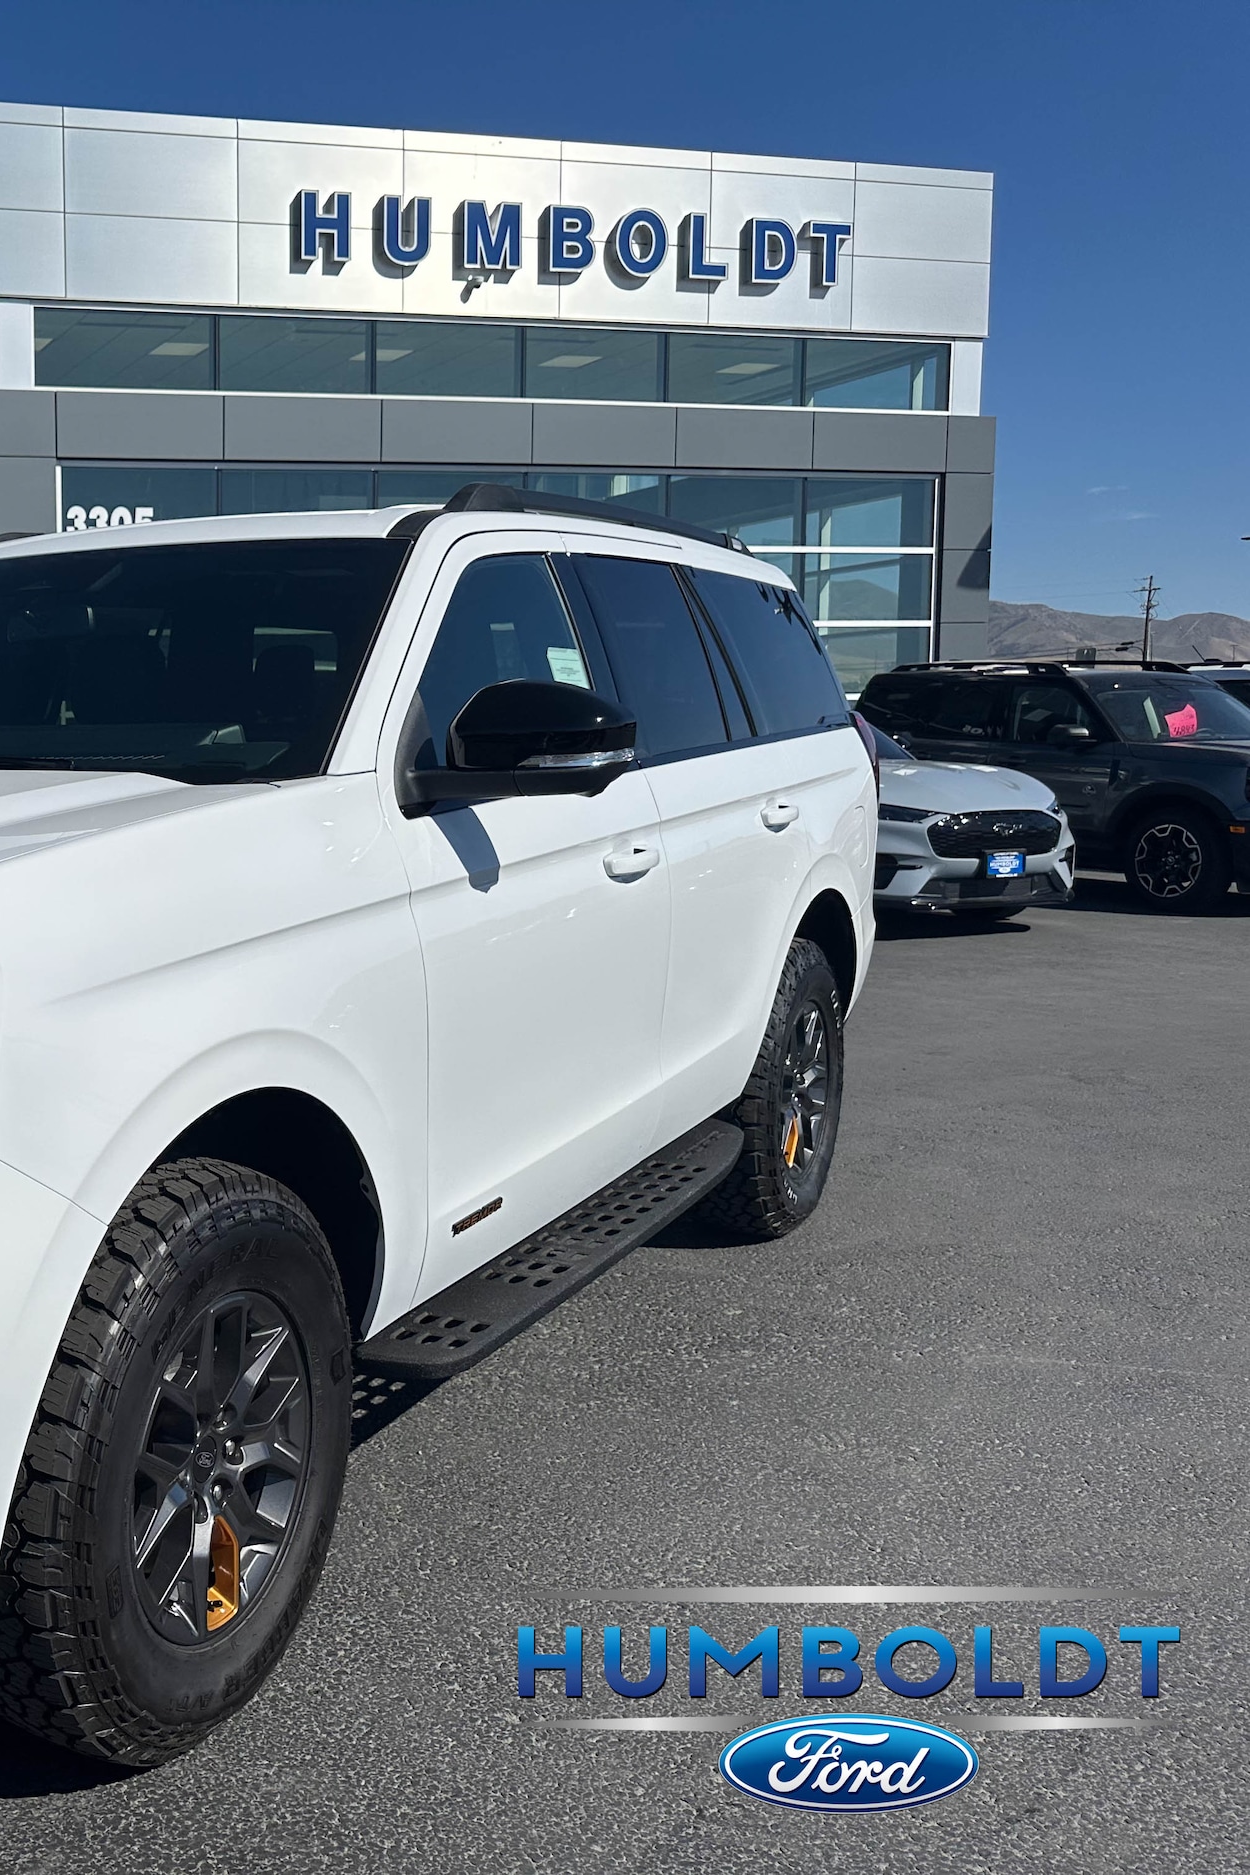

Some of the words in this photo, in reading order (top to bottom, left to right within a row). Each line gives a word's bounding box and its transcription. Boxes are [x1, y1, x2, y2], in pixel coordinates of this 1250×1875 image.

[298, 189, 853, 287] HUMBOLDT
[451, 1196, 503, 1237] TREMOR
[151, 1237, 279, 1365] GENERAL
